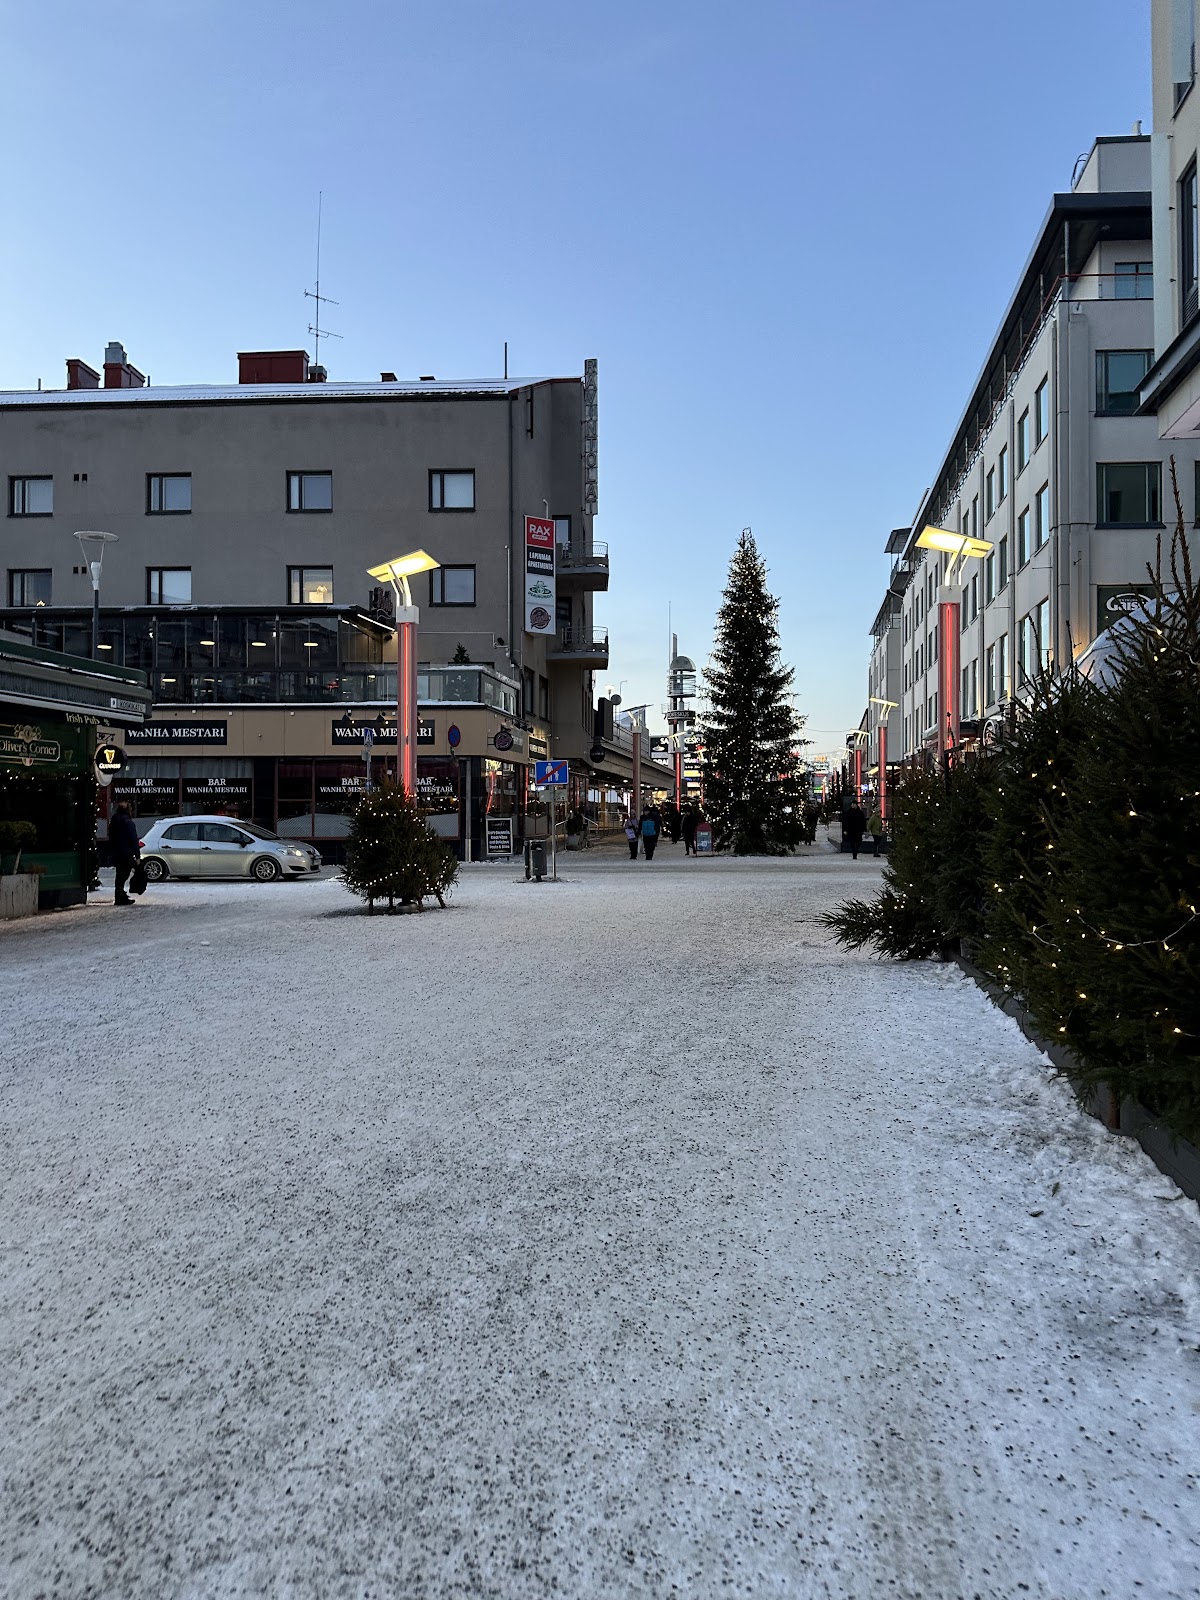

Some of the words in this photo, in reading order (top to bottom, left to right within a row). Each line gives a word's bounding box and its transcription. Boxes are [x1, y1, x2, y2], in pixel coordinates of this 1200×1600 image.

[529, 524, 551, 536] RAX
[65, 712, 83, 724] Irish
[127, 728, 170, 737] WANHA
[172, 728, 225, 738] MESTARI
[29, 742, 57, 755] Corner
[135, 778, 154, 787] BAR
[207, 778, 227, 786] BAR
[341, 778, 360, 786] BAR
